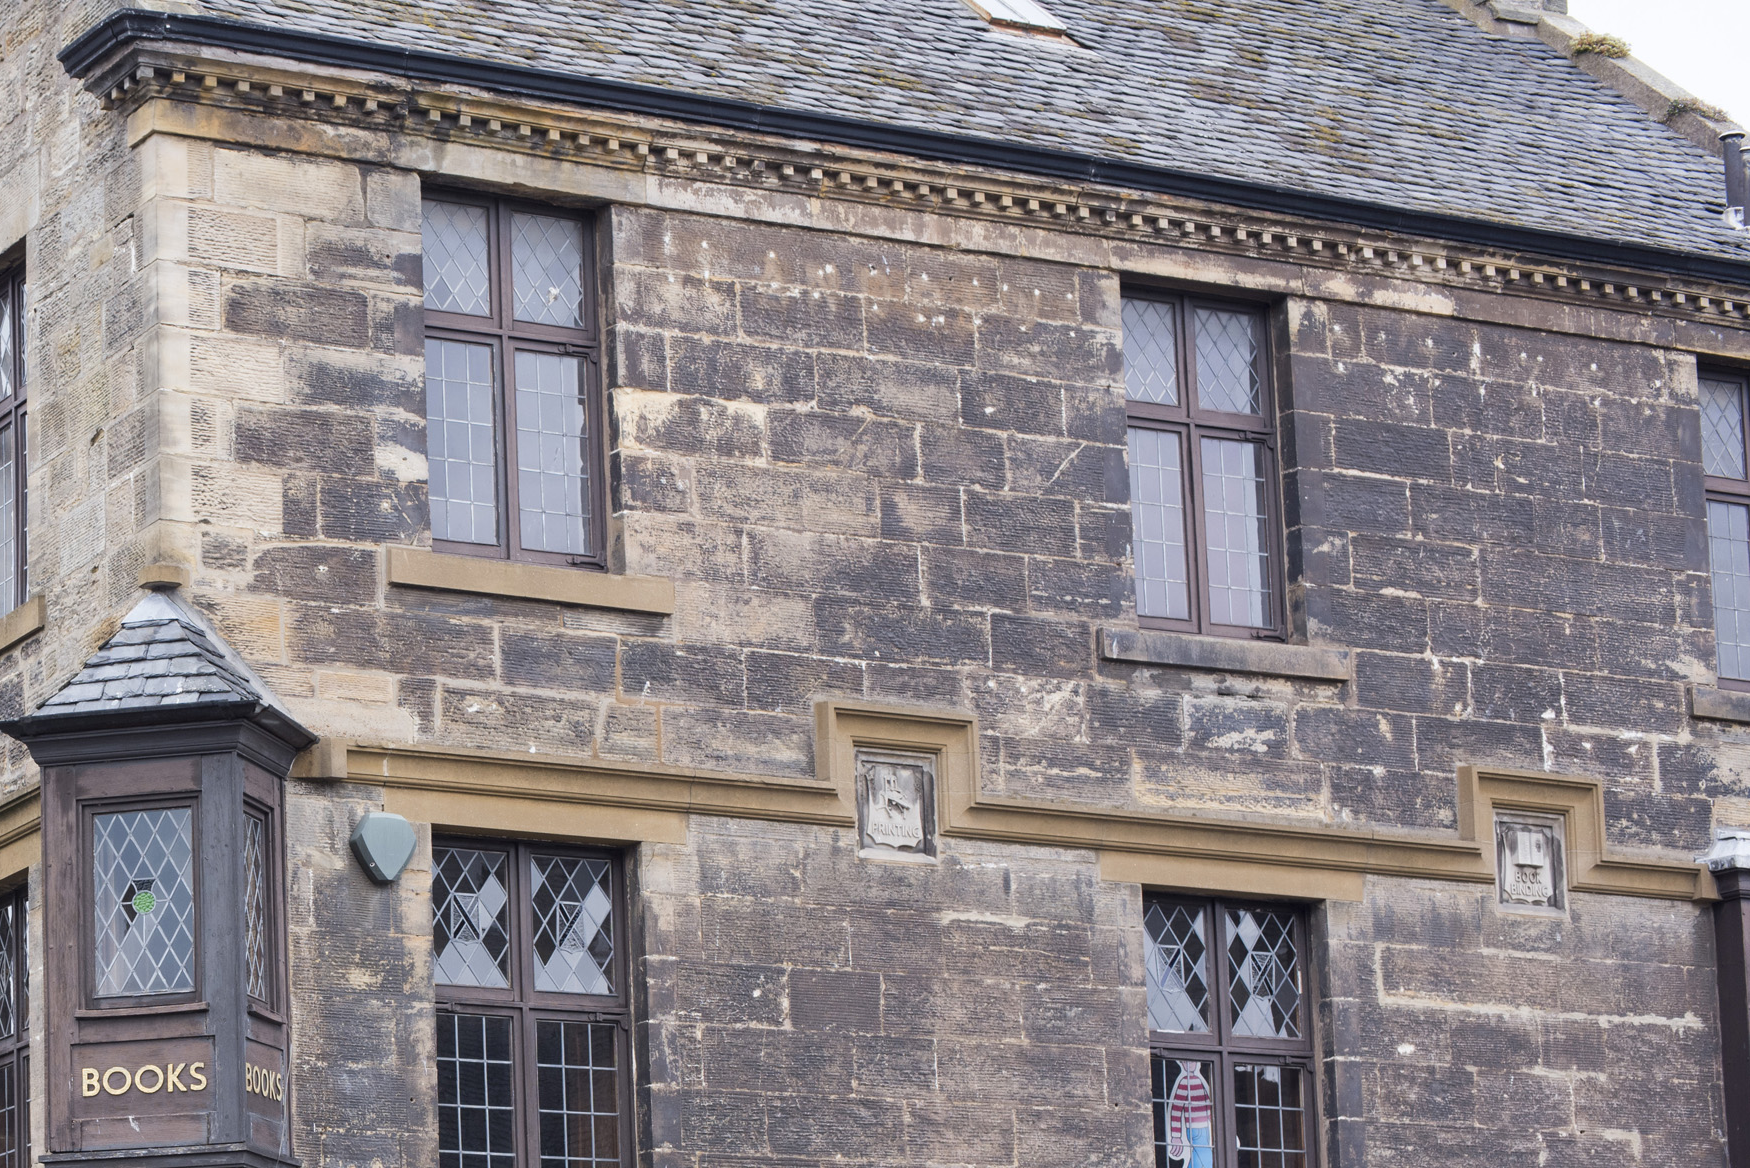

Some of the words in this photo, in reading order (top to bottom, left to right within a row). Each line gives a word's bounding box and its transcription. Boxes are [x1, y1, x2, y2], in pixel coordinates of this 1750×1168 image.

[872, 821, 920, 838] PRINTING
[1515, 870, 1542, 885] BOOK
[1510, 883, 1550, 898] BINDING
[81, 1062, 208, 1097] BOOKS
[245, 1062, 283, 1101] BOOKS
